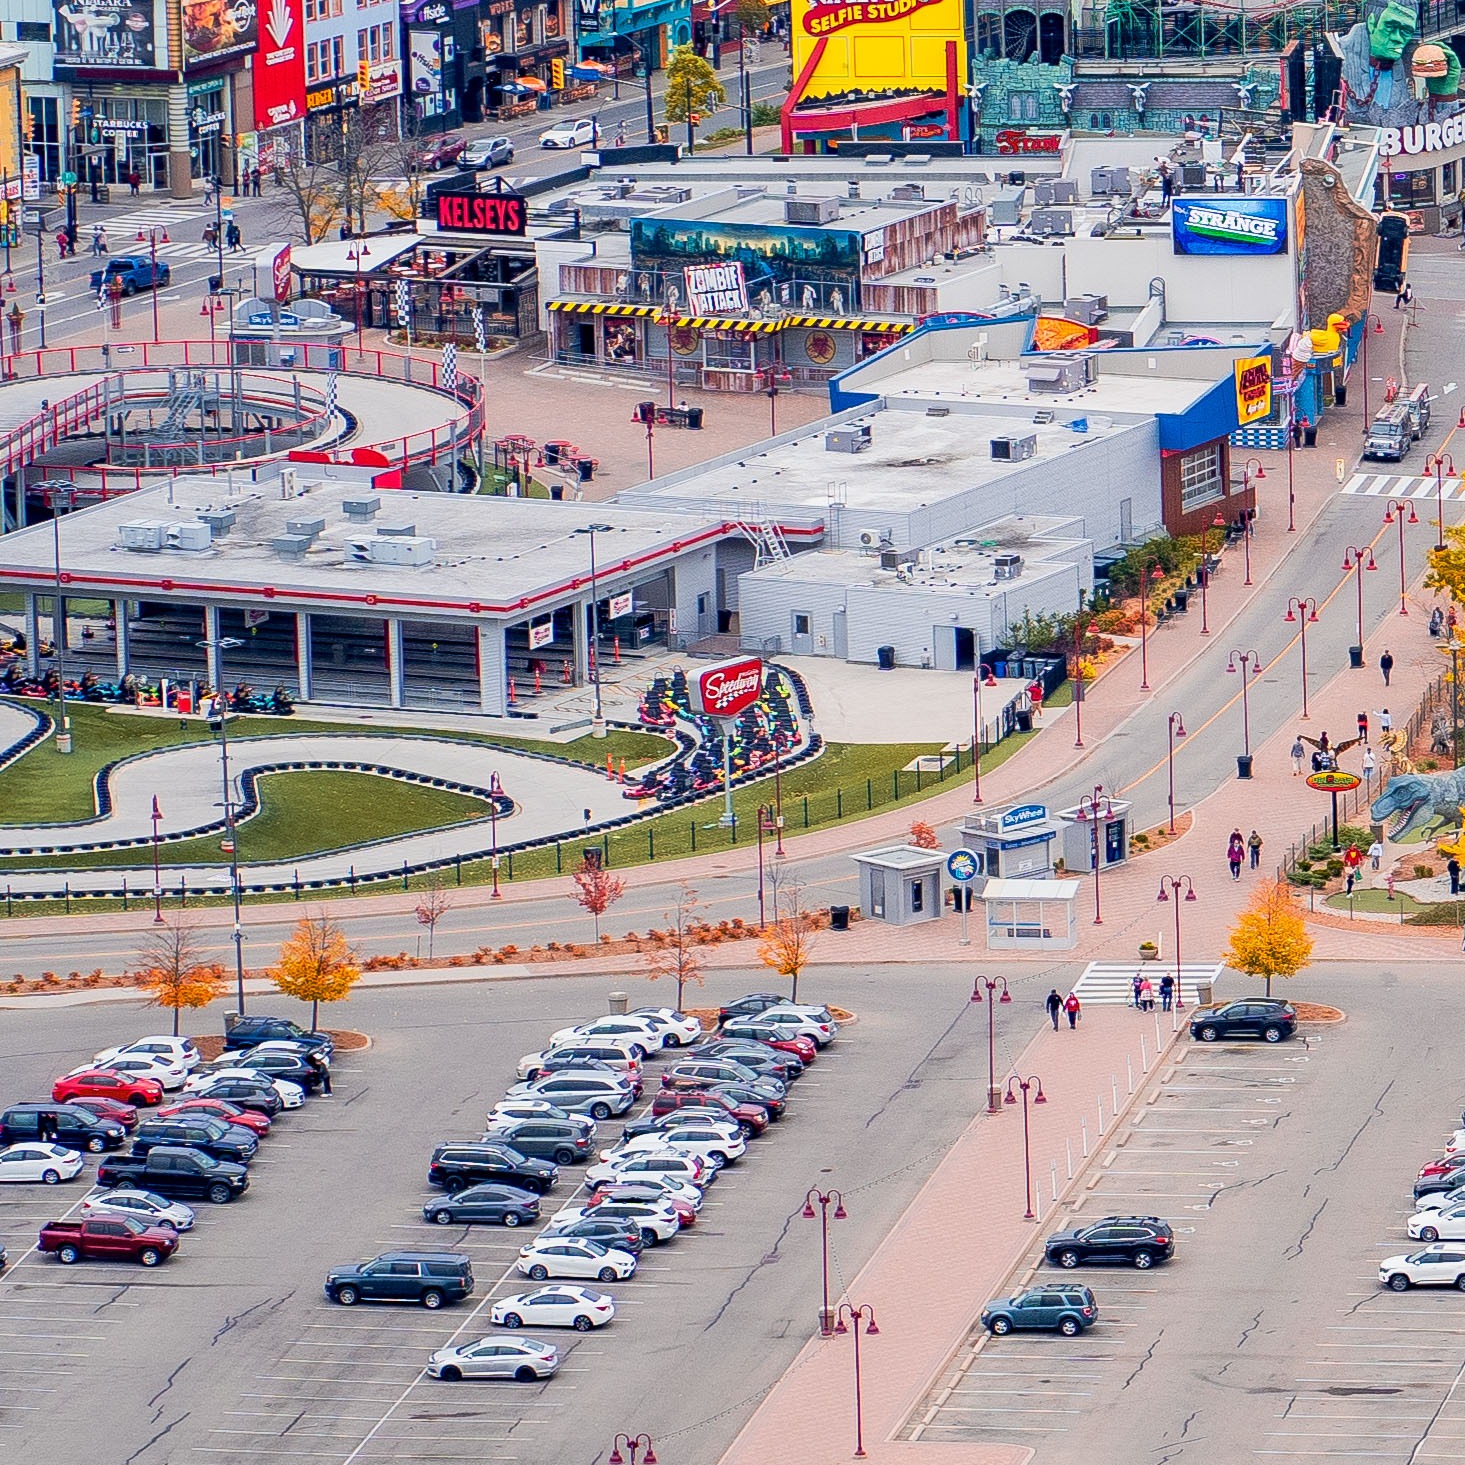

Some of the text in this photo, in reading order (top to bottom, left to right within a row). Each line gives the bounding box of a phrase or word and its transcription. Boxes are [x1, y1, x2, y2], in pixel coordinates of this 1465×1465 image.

[810, 5, 863, 34] SELFIE
[92, 118, 149, 129] STARBUCKS
[439, 196, 519, 231] KELSEYS
[1188, 209, 1277, 237] STRANGE
[690, 266, 740, 294] ZOMBIE
[699, 291, 743, 313] ATTACK
[705, 672, 760, 700] Speedway
[1004, 808, 1044, 824] SkyWheel
